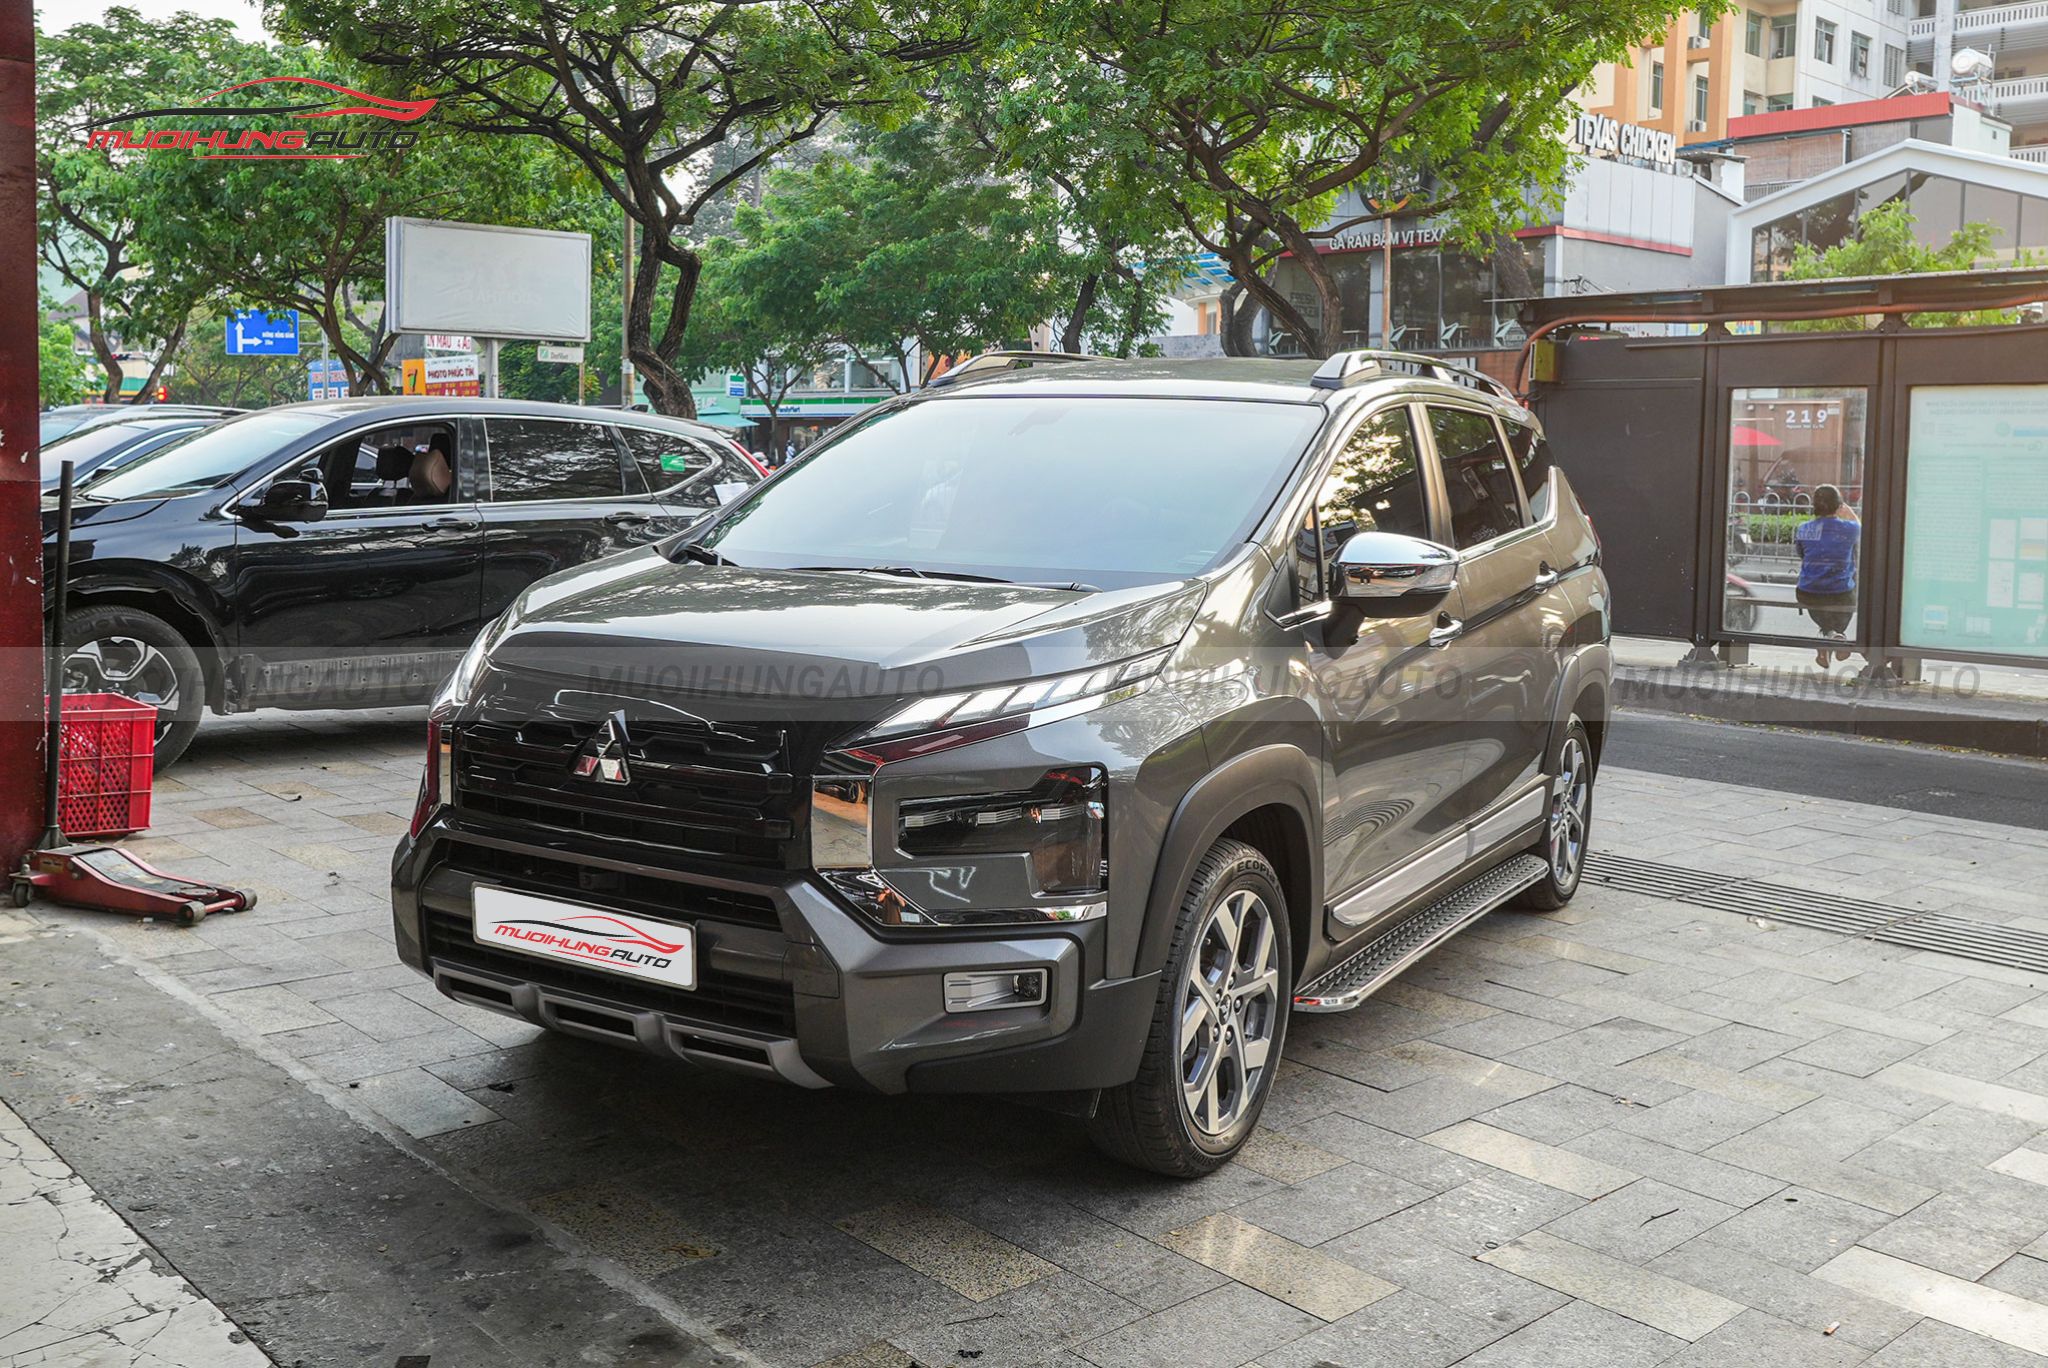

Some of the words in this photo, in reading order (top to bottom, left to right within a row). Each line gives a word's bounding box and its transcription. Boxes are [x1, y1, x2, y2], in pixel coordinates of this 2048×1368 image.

[1576, 112, 1618, 153] TEXAS
[1620, 123, 1676, 165] CHICKEN
[427, 369, 447, 379] PHOTO
